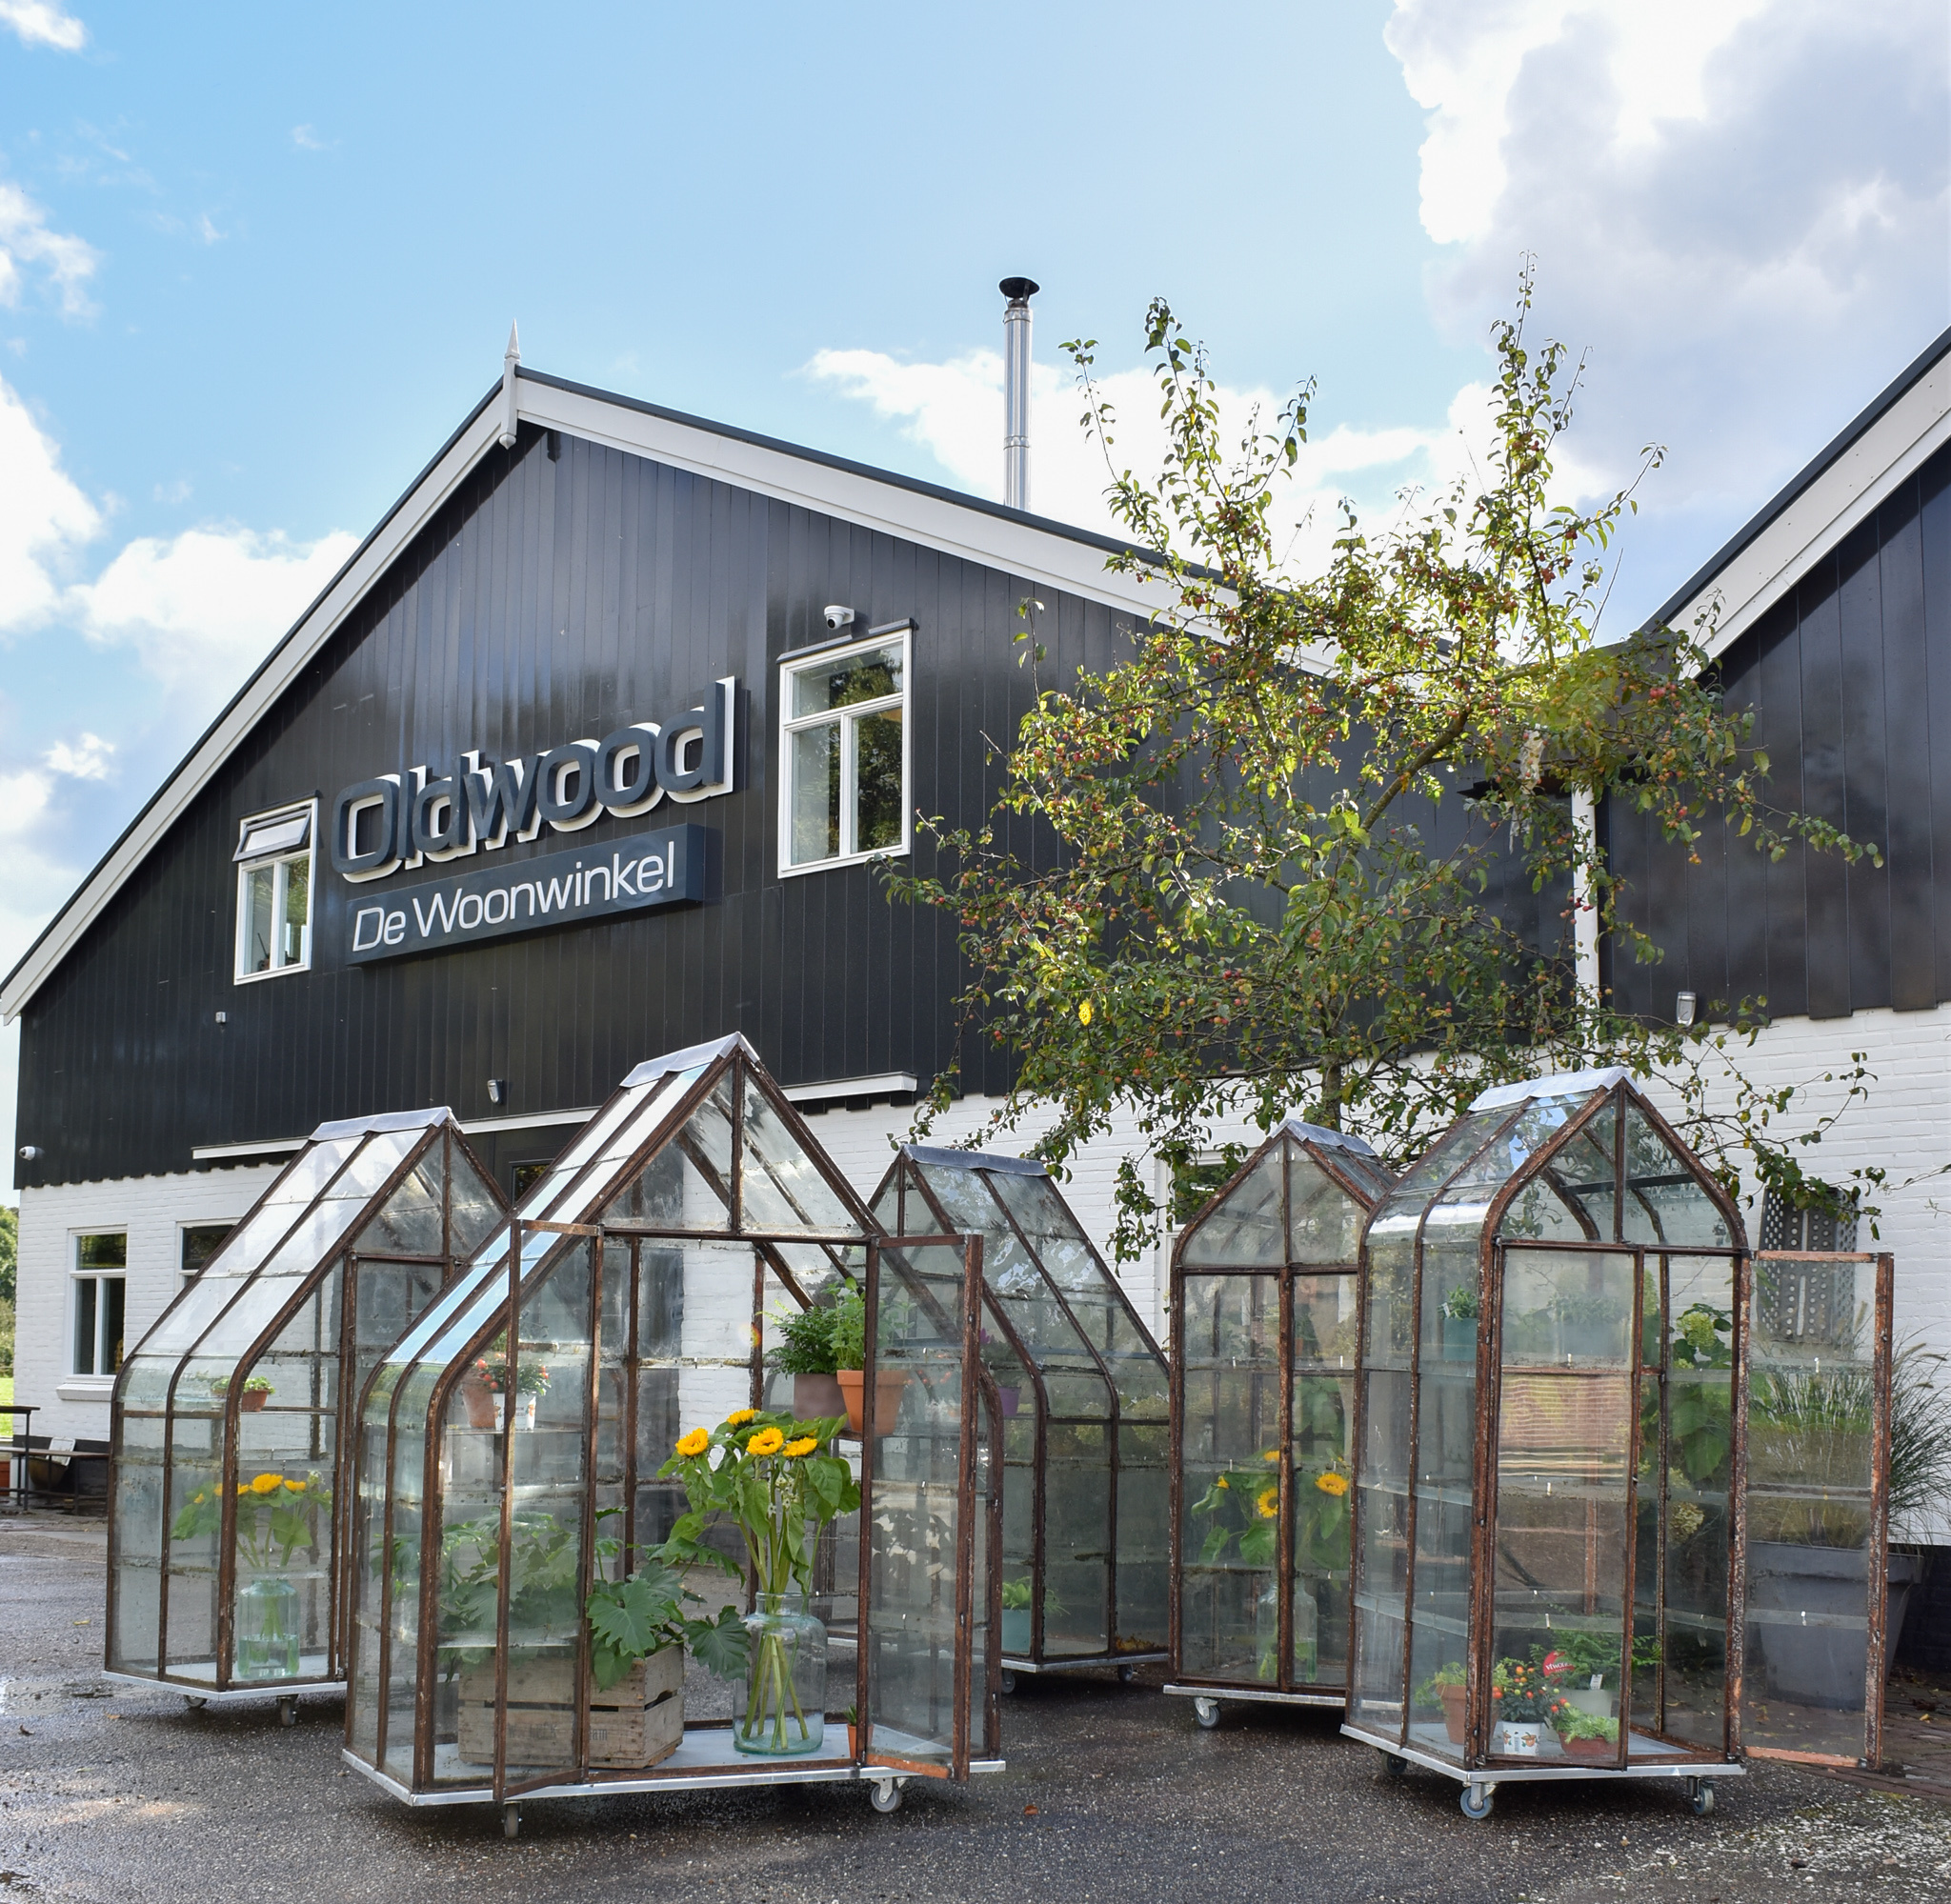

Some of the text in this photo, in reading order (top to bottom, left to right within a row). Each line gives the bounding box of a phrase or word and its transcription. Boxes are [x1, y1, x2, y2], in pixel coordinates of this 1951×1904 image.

[332, 676, 734, 883] Oldwood
[352, 841, 674, 952] De Woonwinkel
